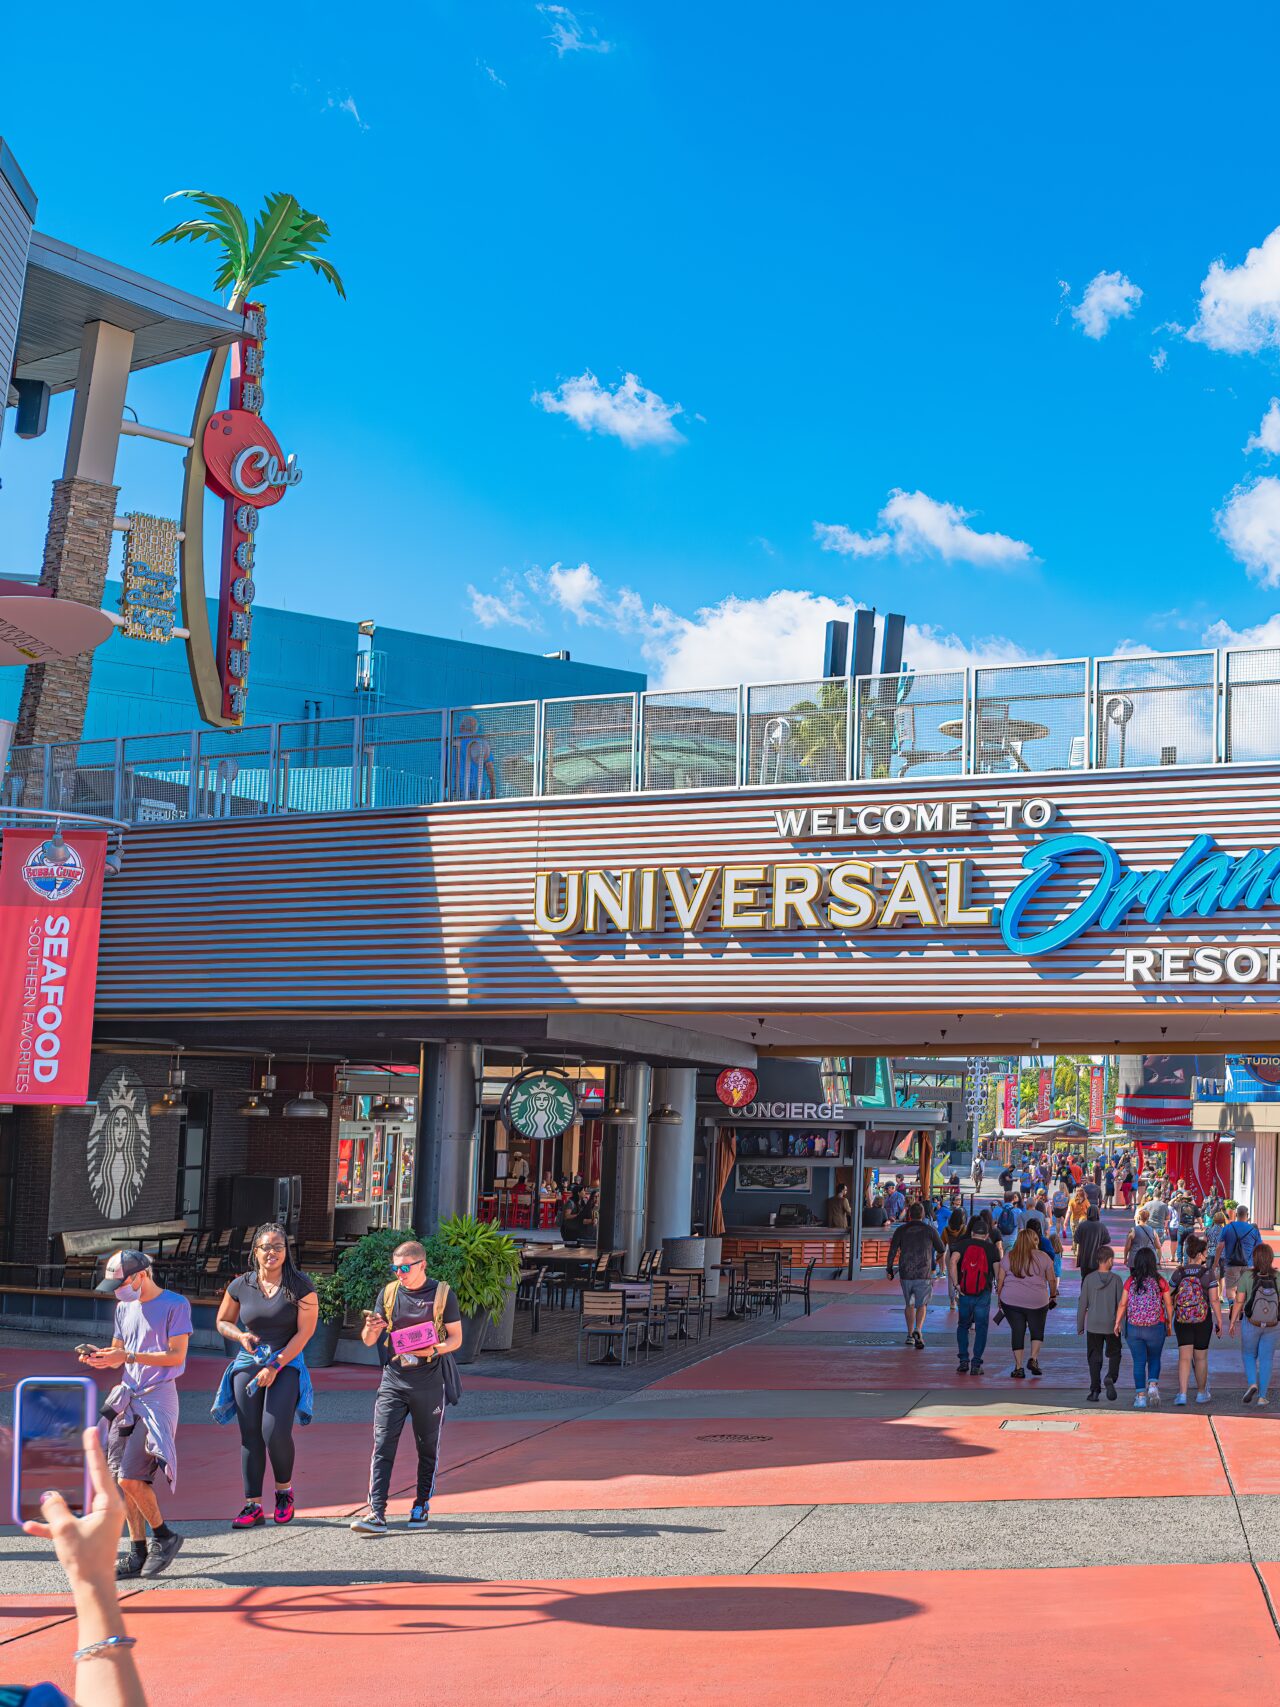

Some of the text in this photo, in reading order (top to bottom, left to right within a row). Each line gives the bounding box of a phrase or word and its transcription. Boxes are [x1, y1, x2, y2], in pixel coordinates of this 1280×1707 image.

[231, 446, 302, 496] Club
[773, 797, 1056, 837] WELCOME TO
[534, 860, 993, 934] UNIVERSAL
[33, 915, 71, 1083] SEAFOOD
[16, 1012, 36, 1093] FAVORITES
